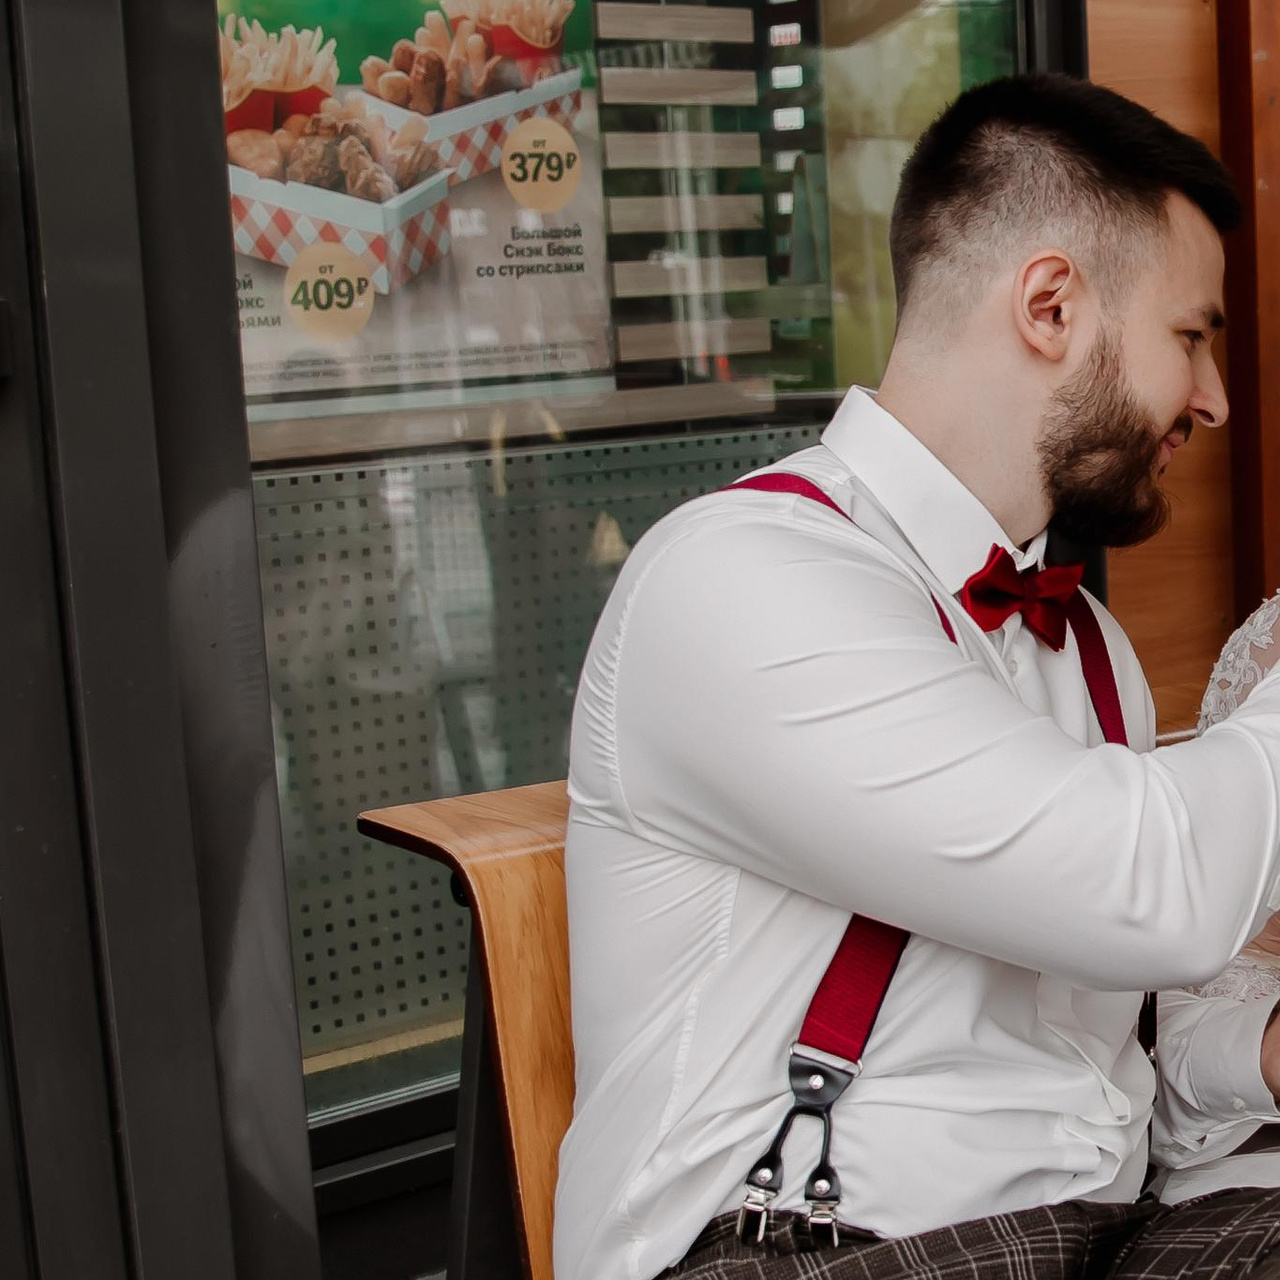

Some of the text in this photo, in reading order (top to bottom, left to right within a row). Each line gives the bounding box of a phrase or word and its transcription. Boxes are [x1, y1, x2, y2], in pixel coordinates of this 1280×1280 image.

[503, 241, 584, 258] Снэк Бокс
[318, 264, 335, 274] от
[476, 261, 585, 279] со стрипсами
